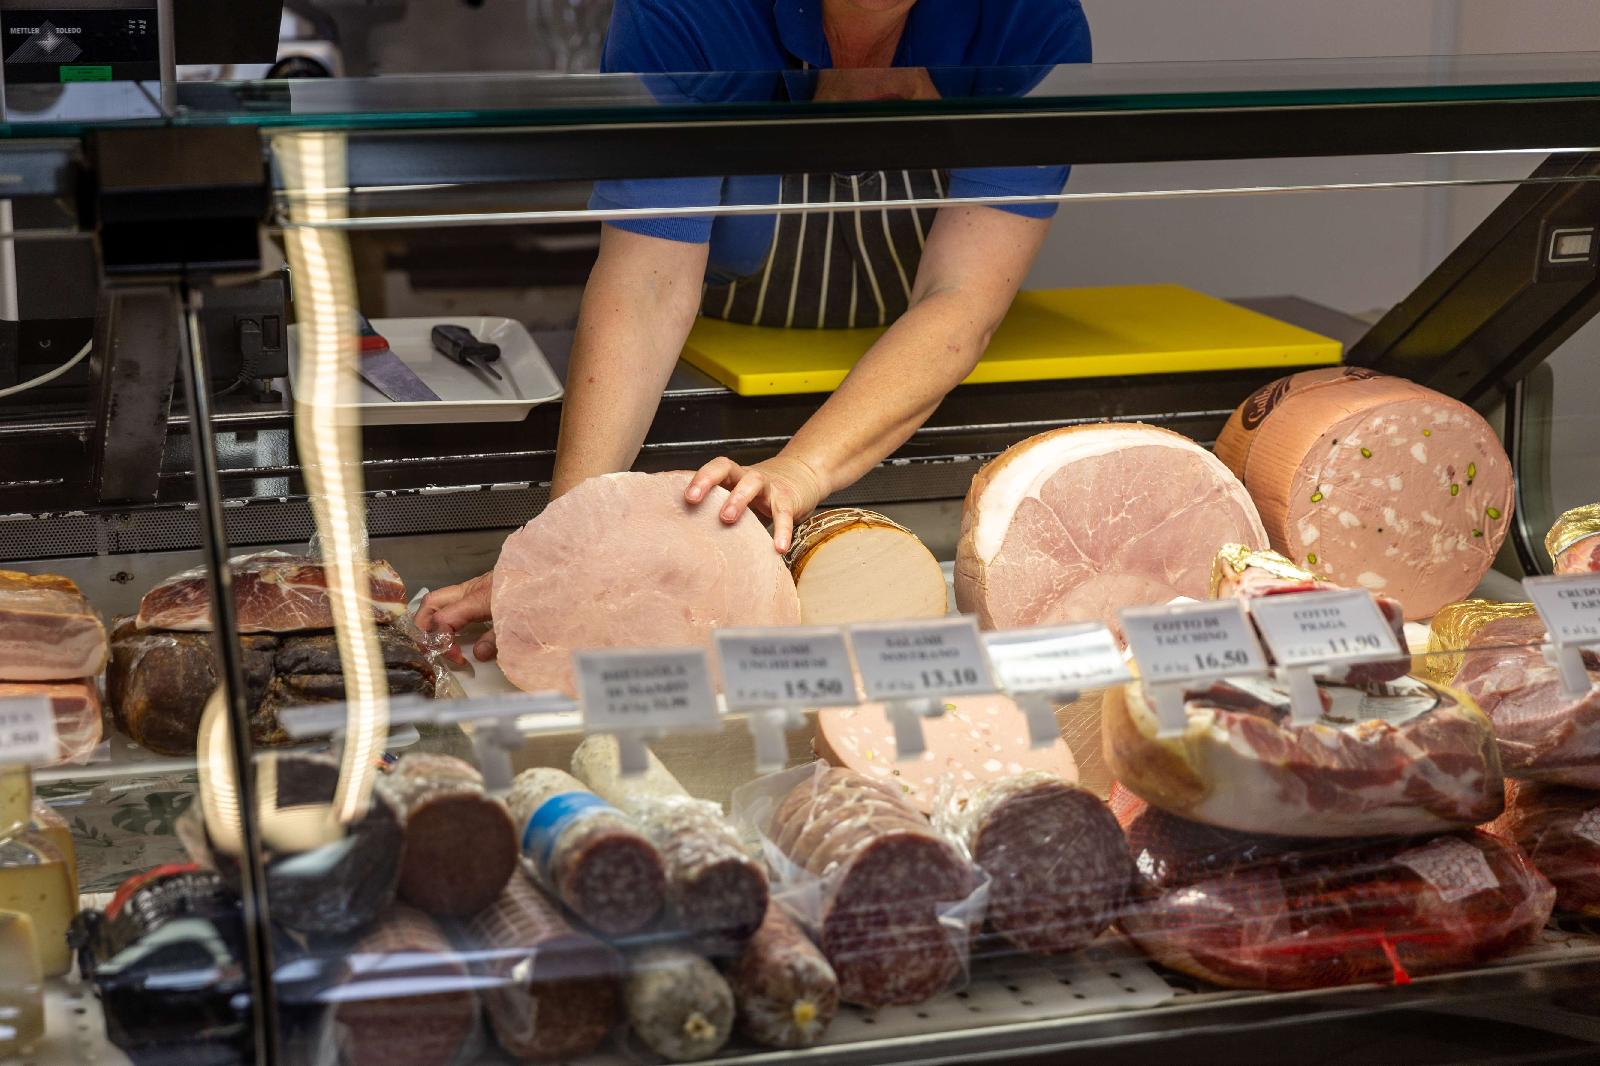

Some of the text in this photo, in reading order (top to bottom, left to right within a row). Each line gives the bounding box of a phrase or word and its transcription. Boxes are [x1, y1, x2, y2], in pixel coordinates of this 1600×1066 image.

[1293, 608, 1340, 619] COTTO
[1300, 621, 1346, 632] PRAGA
[1328, 634, 1380, 652] 11,90
[1195, 650, 1249, 669] 16,50
[921, 668, 978, 688] 13,10
[784, 678, 843, 697] 15,50
